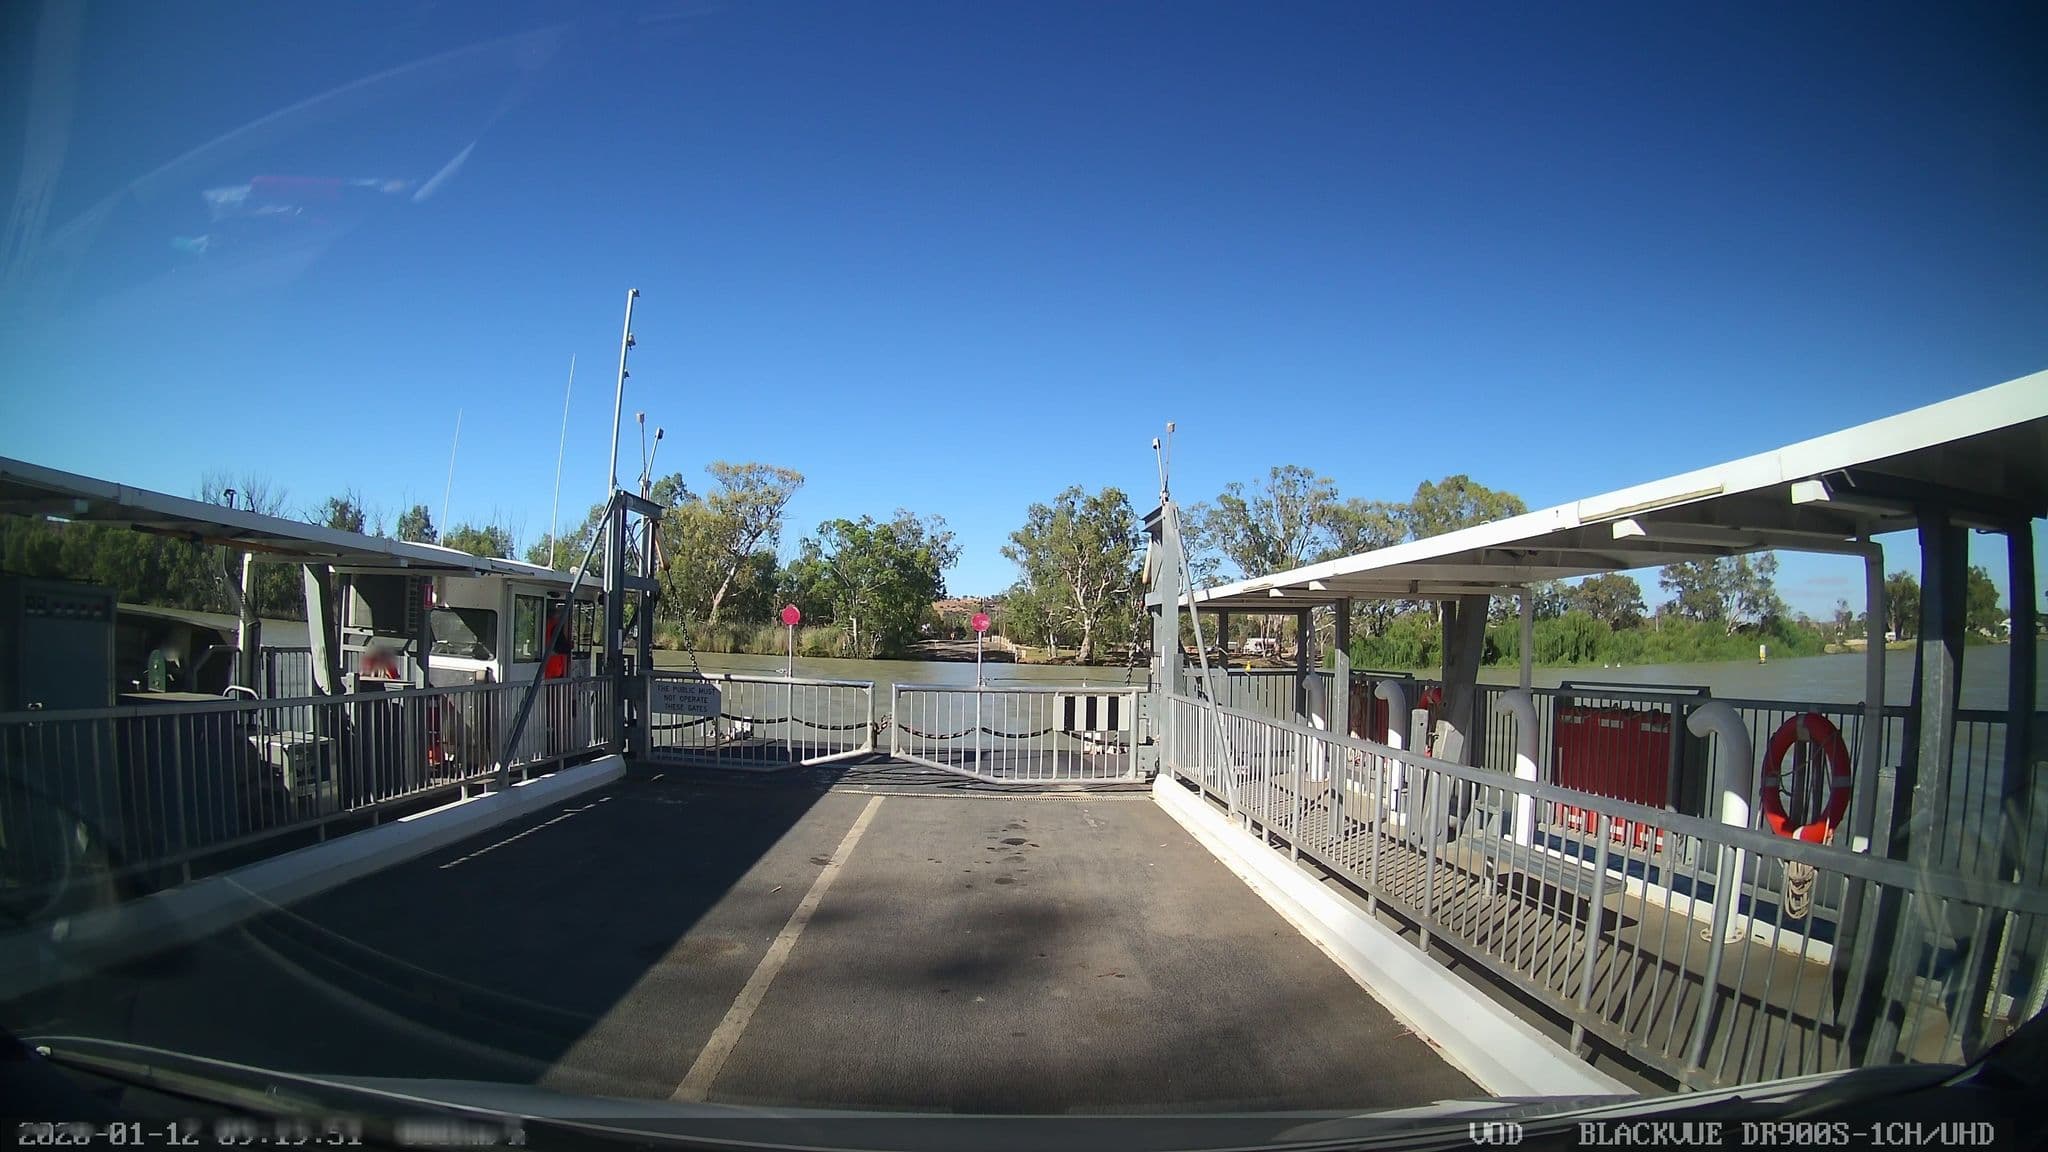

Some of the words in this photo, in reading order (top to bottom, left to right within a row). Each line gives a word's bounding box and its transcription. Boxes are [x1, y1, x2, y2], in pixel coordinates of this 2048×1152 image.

[657, 684, 669, 692] THE
[672, 685, 695, 694] PUBLIC
[698, 687, 716, 696] MUST
[663, 694, 677, 702] NOT
[679, 695, 709, 704] OPERATE
[664, 703, 684, 711] THESE
[687, 704, 709, 713] GATES
